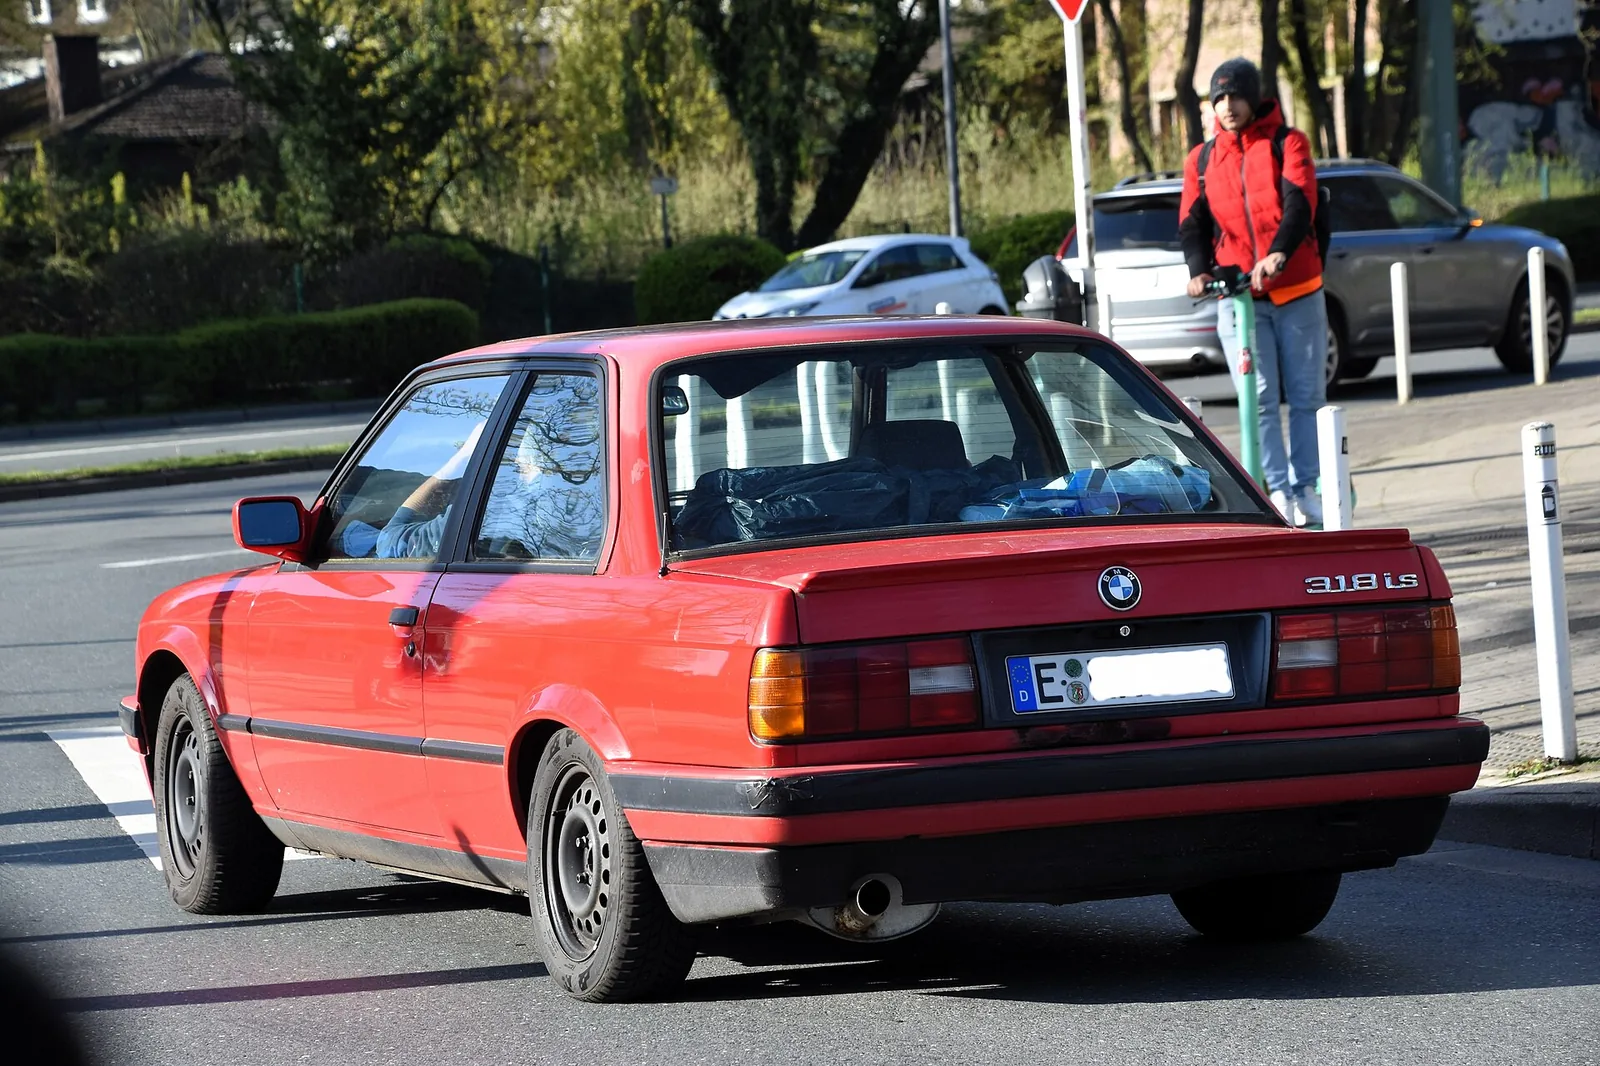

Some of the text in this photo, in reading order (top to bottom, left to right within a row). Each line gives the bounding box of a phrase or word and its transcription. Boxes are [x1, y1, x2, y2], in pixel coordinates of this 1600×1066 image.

[1103, 569, 1135, 582] BMW
[1034, 662, 1064, 704] E
[1019, 690, 1029, 702] D
